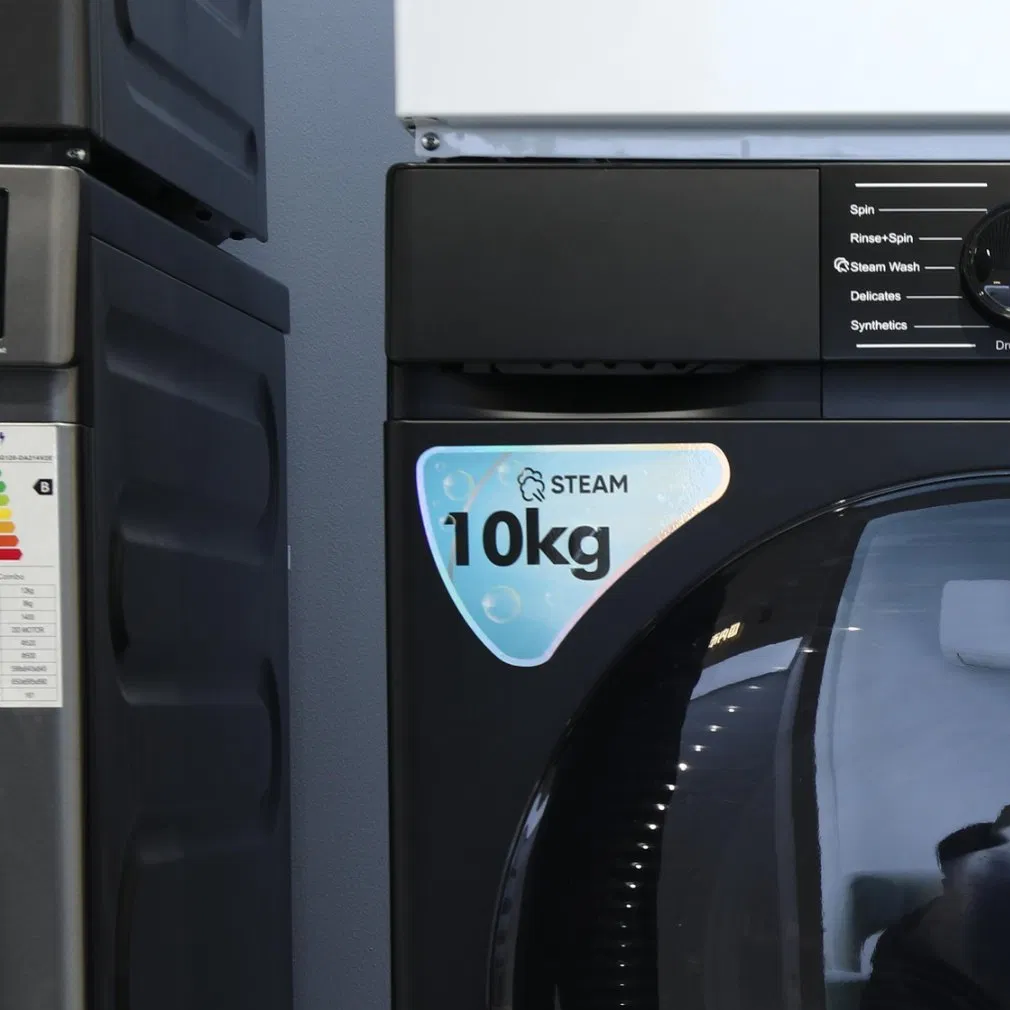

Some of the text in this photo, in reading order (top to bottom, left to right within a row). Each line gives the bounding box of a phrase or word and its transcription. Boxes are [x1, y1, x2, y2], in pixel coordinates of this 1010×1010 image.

[850, 203, 875, 217] Spin
[850, 232, 914, 245] Rinse+Spin
[850, 261, 920, 273] Steam Wash
[850, 290, 901, 302] Delicates
[850, 319, 908, 332] Synthetics
[41, 481, 50, 493] B
[551, 474, 628, 494] STEAM
[444, 507, 610, 581] 10kg
